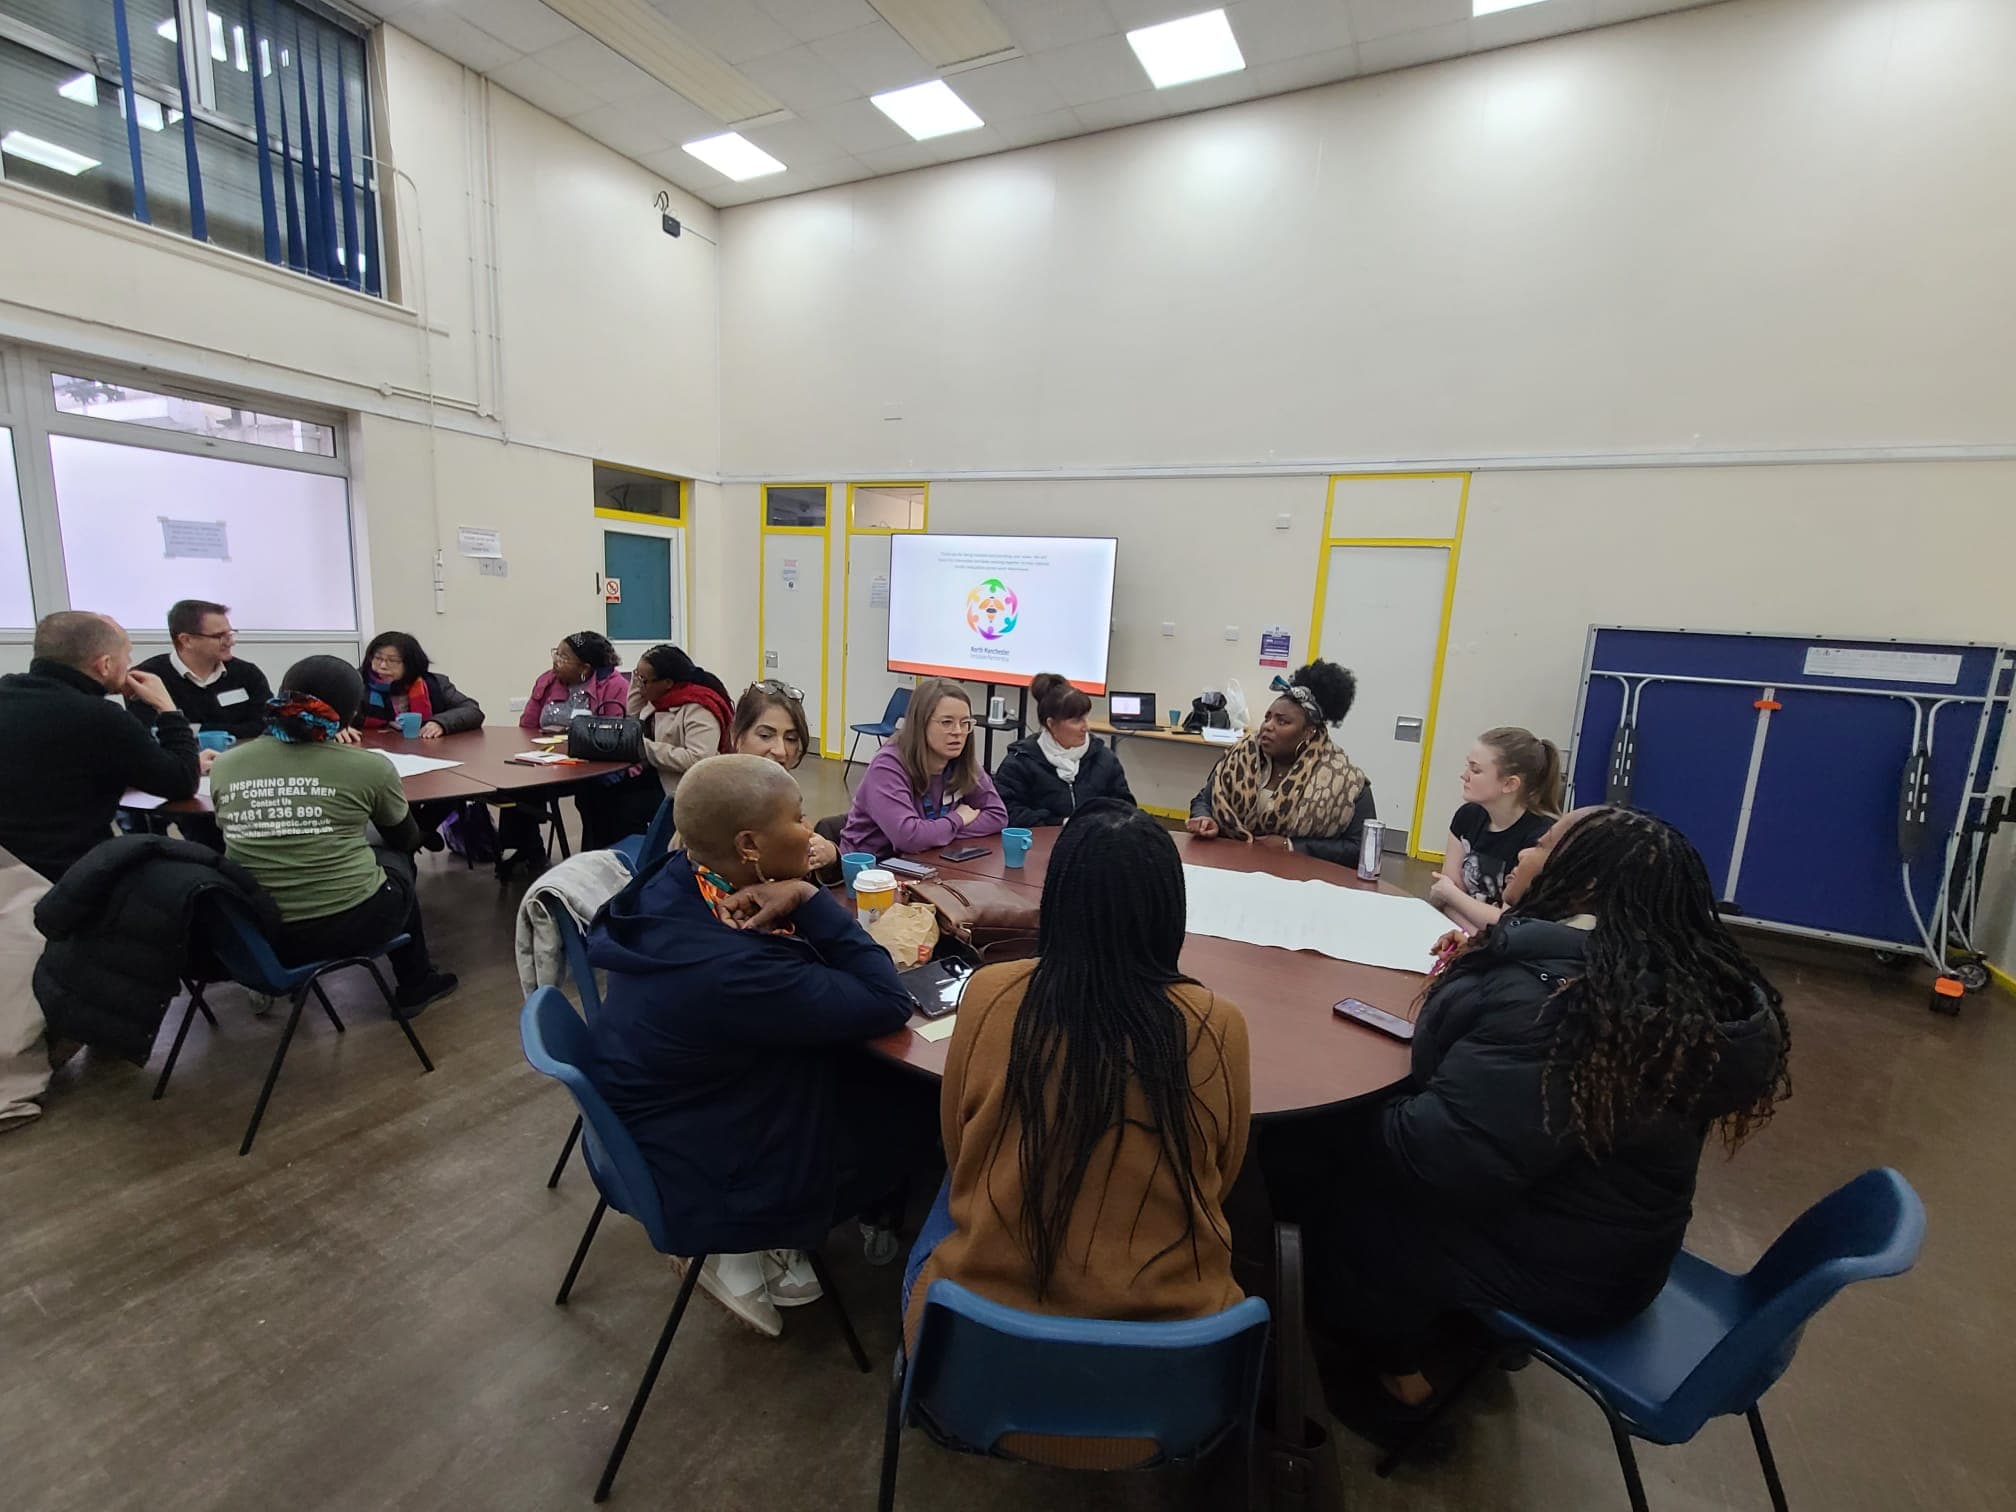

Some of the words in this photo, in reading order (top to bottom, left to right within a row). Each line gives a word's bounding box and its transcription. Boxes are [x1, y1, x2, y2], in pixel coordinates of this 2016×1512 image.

[229, 778, 285, 792] INSPIRING
[288, 777, 320, 787] BOYS
[278, 786, 308, 796] REAL
[310, 787, 337, 798] MEN
[250, 798, 281, 808] Contact
[281, 797, 292, 806] Us
[267, 806, 293, 819] 236
[297, 806, 323, 818] 890
